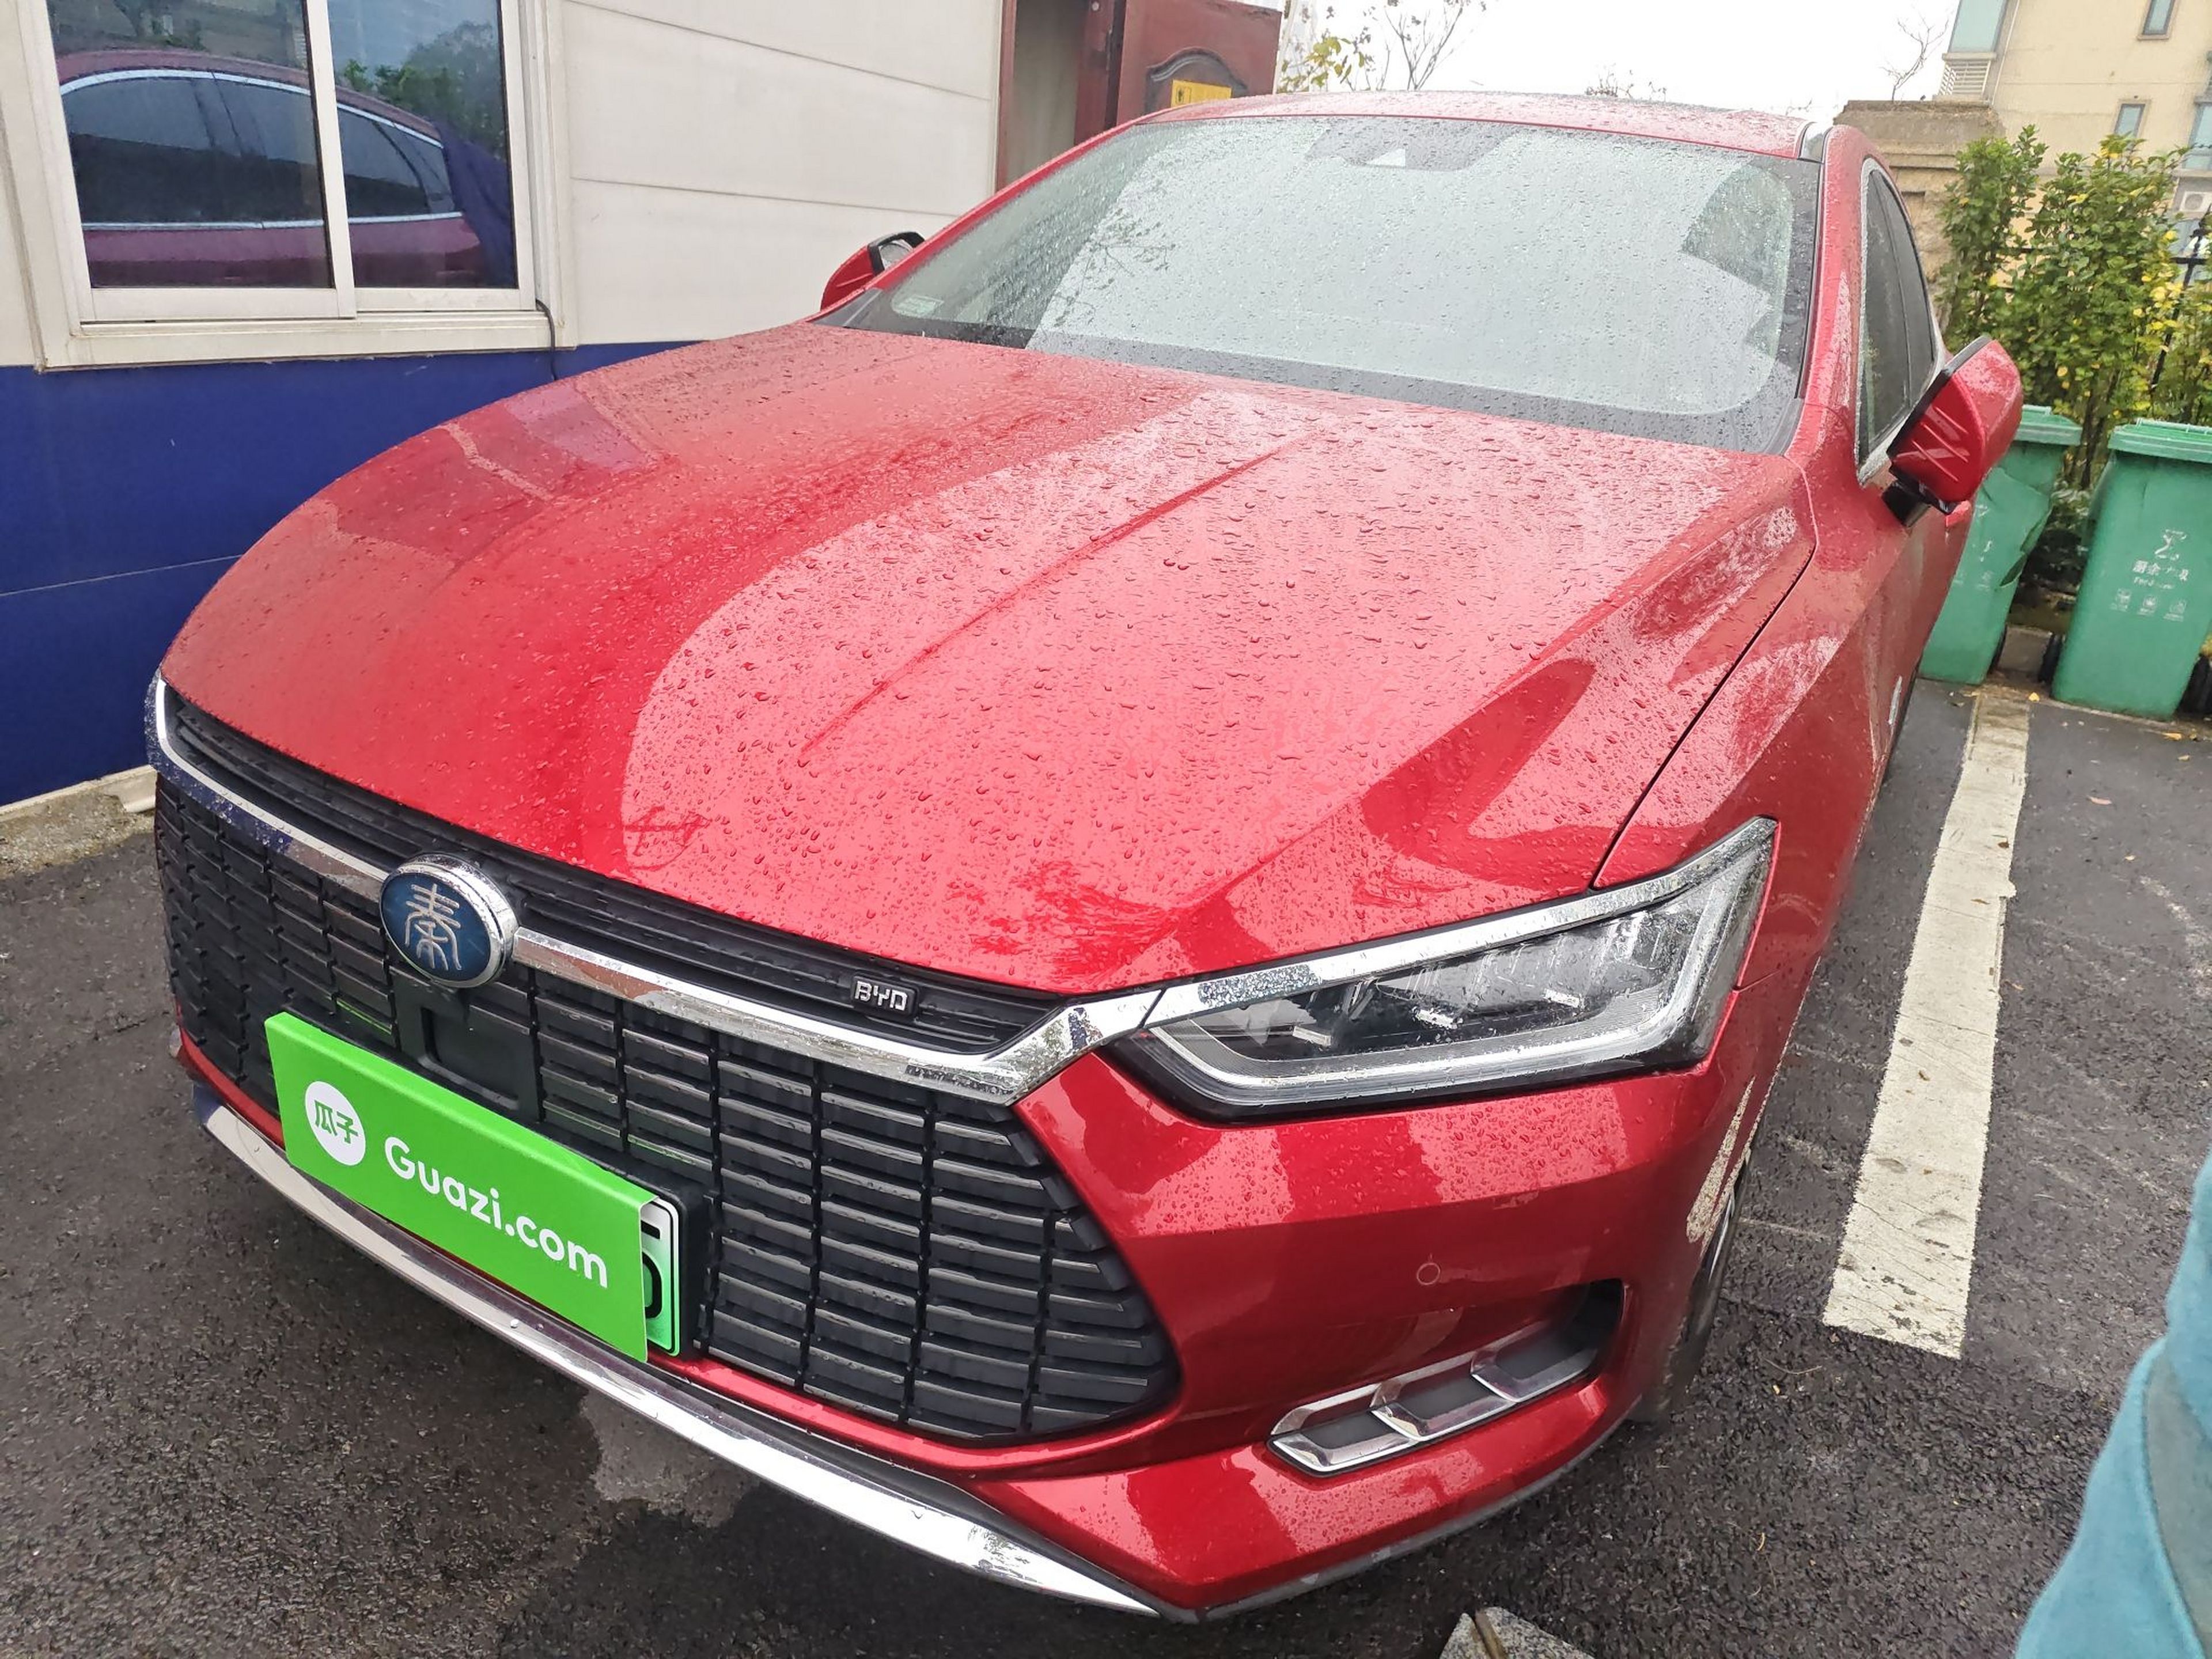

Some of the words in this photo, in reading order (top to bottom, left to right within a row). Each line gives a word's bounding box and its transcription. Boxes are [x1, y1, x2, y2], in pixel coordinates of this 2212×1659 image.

[855, 980, 908, 1011] BYD
[315, 1099, 358, 1144] 瓜子
[384, 1137, 608, 1288] Guazi.com
